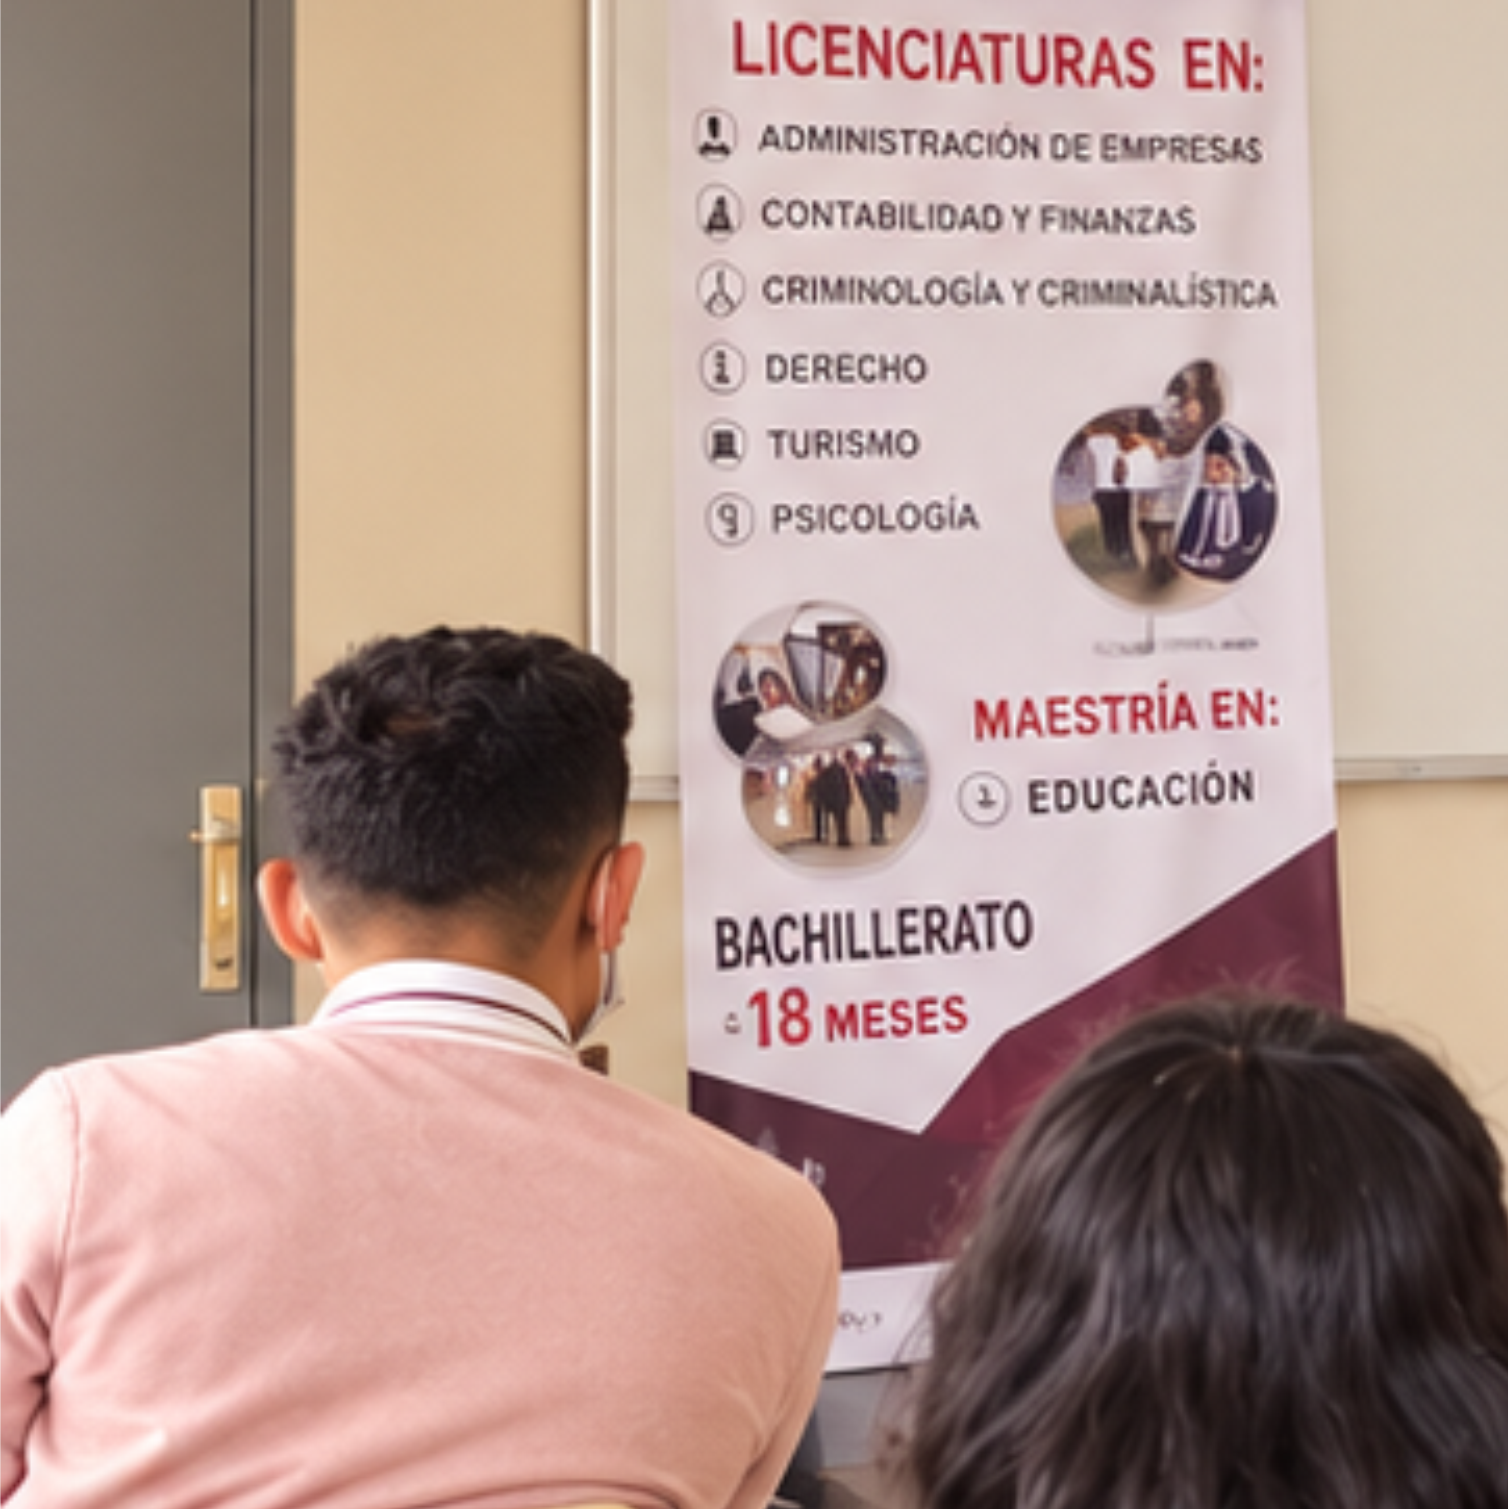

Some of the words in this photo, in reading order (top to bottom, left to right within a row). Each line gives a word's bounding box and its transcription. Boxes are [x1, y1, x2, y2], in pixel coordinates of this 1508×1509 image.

[733, 19, 1156, 90] LICENCIATURAS
[1182, 38, 1264, 93] EN:
[757, 124, 1041, 160] ADMINISTRACIÓN
[1049, 132, 1092, 163] DE
[1100, 132, 1263, 165] EMPRESAS
[760, 197, 1004, 234] CONTABILIDAD
[1011, 204, 1031, 233] Y
[1039, 204, 1197, 236] FINANZAS
[761, 271, 1005, 307] CRIMINOLOGÍA
[1011, 278, 1031, 306] Y
[1037, 272, 1278, 309] CRIMINALÍSTICA
[765, 352, 928, 385] DERECHO
[767, 428, 921, 460] TURISMO
[771, 495, 980, 535] PSICOLOGÍA
[973, 679, 1199, 742] MAESTRÍA
[1210, 688, 1279, 731] EN:
[1027, 760, 1254, 815] EDUCACIÓN
[714, 899, 1034, 971] BACHILLERATO
[747, 986, 812, 1049] 18
[825, 994, 969, 1043] MESES
